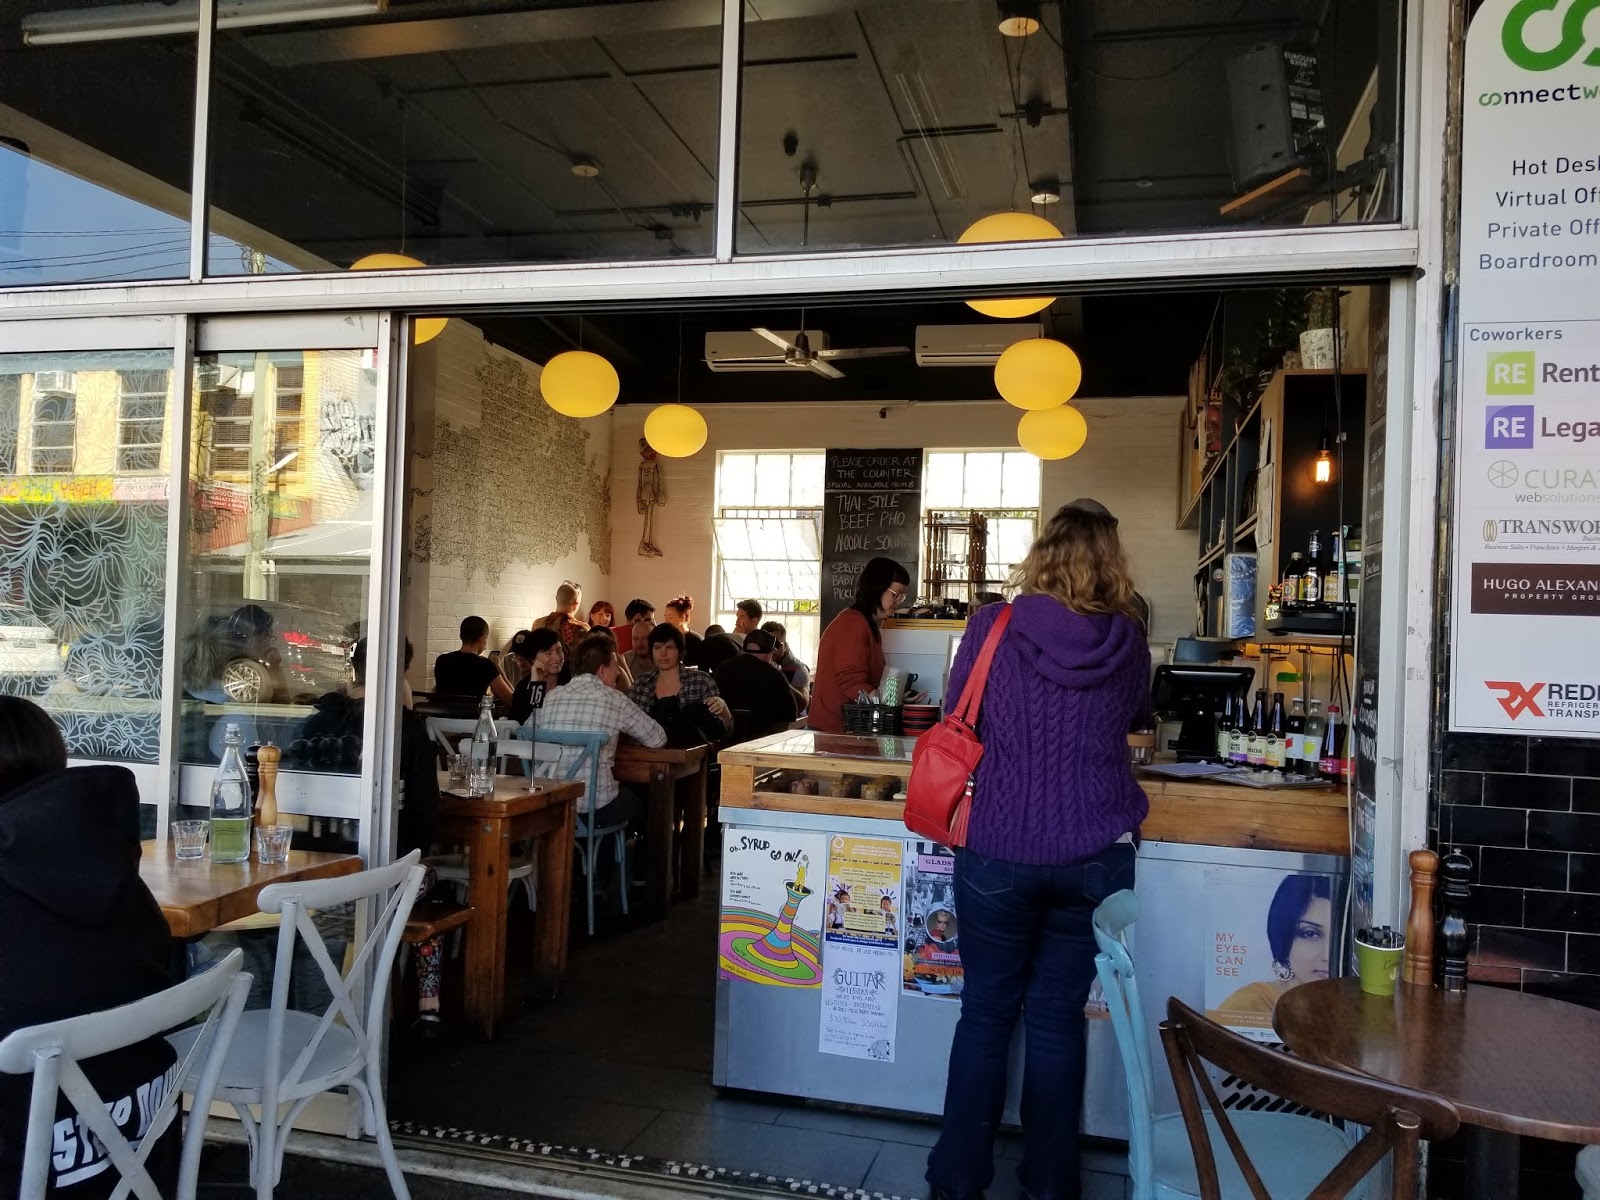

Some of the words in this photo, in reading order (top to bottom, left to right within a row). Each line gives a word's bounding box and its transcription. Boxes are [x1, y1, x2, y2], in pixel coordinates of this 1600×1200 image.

[1479, 84, 1600, 106] connectw
[1512, 159, 1548, 176] Hot
[1556, 155, 1600, 174] Des
[1496, 188, 1567, 208] Virtual
[1574, 187, 1600, 204] Of
[1488, 222, 1562, 239] Private
[1479, 252, 1598, 270] Boardroom
[1469, 327, 1563, 341] Coworkers
[1494, 363, 1527, 384] RE
[1542, 362, 1600, 383] Rent
[1493, 416, 1526, 438] RE
[830, 455, 864, 468] PLEASE
[866, 456, 900, 466] ORDER
[902, 456, 918, 466] AT
[837, 469, 857, 479] THE
[1524, 469, 1600, 489] CURA
[839, 513, 875, 531] BEEF
[880, 511, 906, 527] PHO
[834, 534, 871, 552] NOODLE
[832, 574, 855, 587] BABY
[1483, 578, 1531, 590] HUGO
[1535, 579, 1600, 591] ALEXAN
[833, 587, 855, 600] PICKL
[530, 684, 544, 704] 16
[1547, 708, 1600, 719] TRANSP
[740, 835, 770, 851] SYRUP
[770, 849, 782, 861] GO
[1215, 932, 1235, 942] MY
[1215, 944, 1247, 954] EYES
[1215, 955, 1244, 965] CAN
[836, 969, 886, 990] GUITAR
[1215, 967, 1239, 977] SEE
